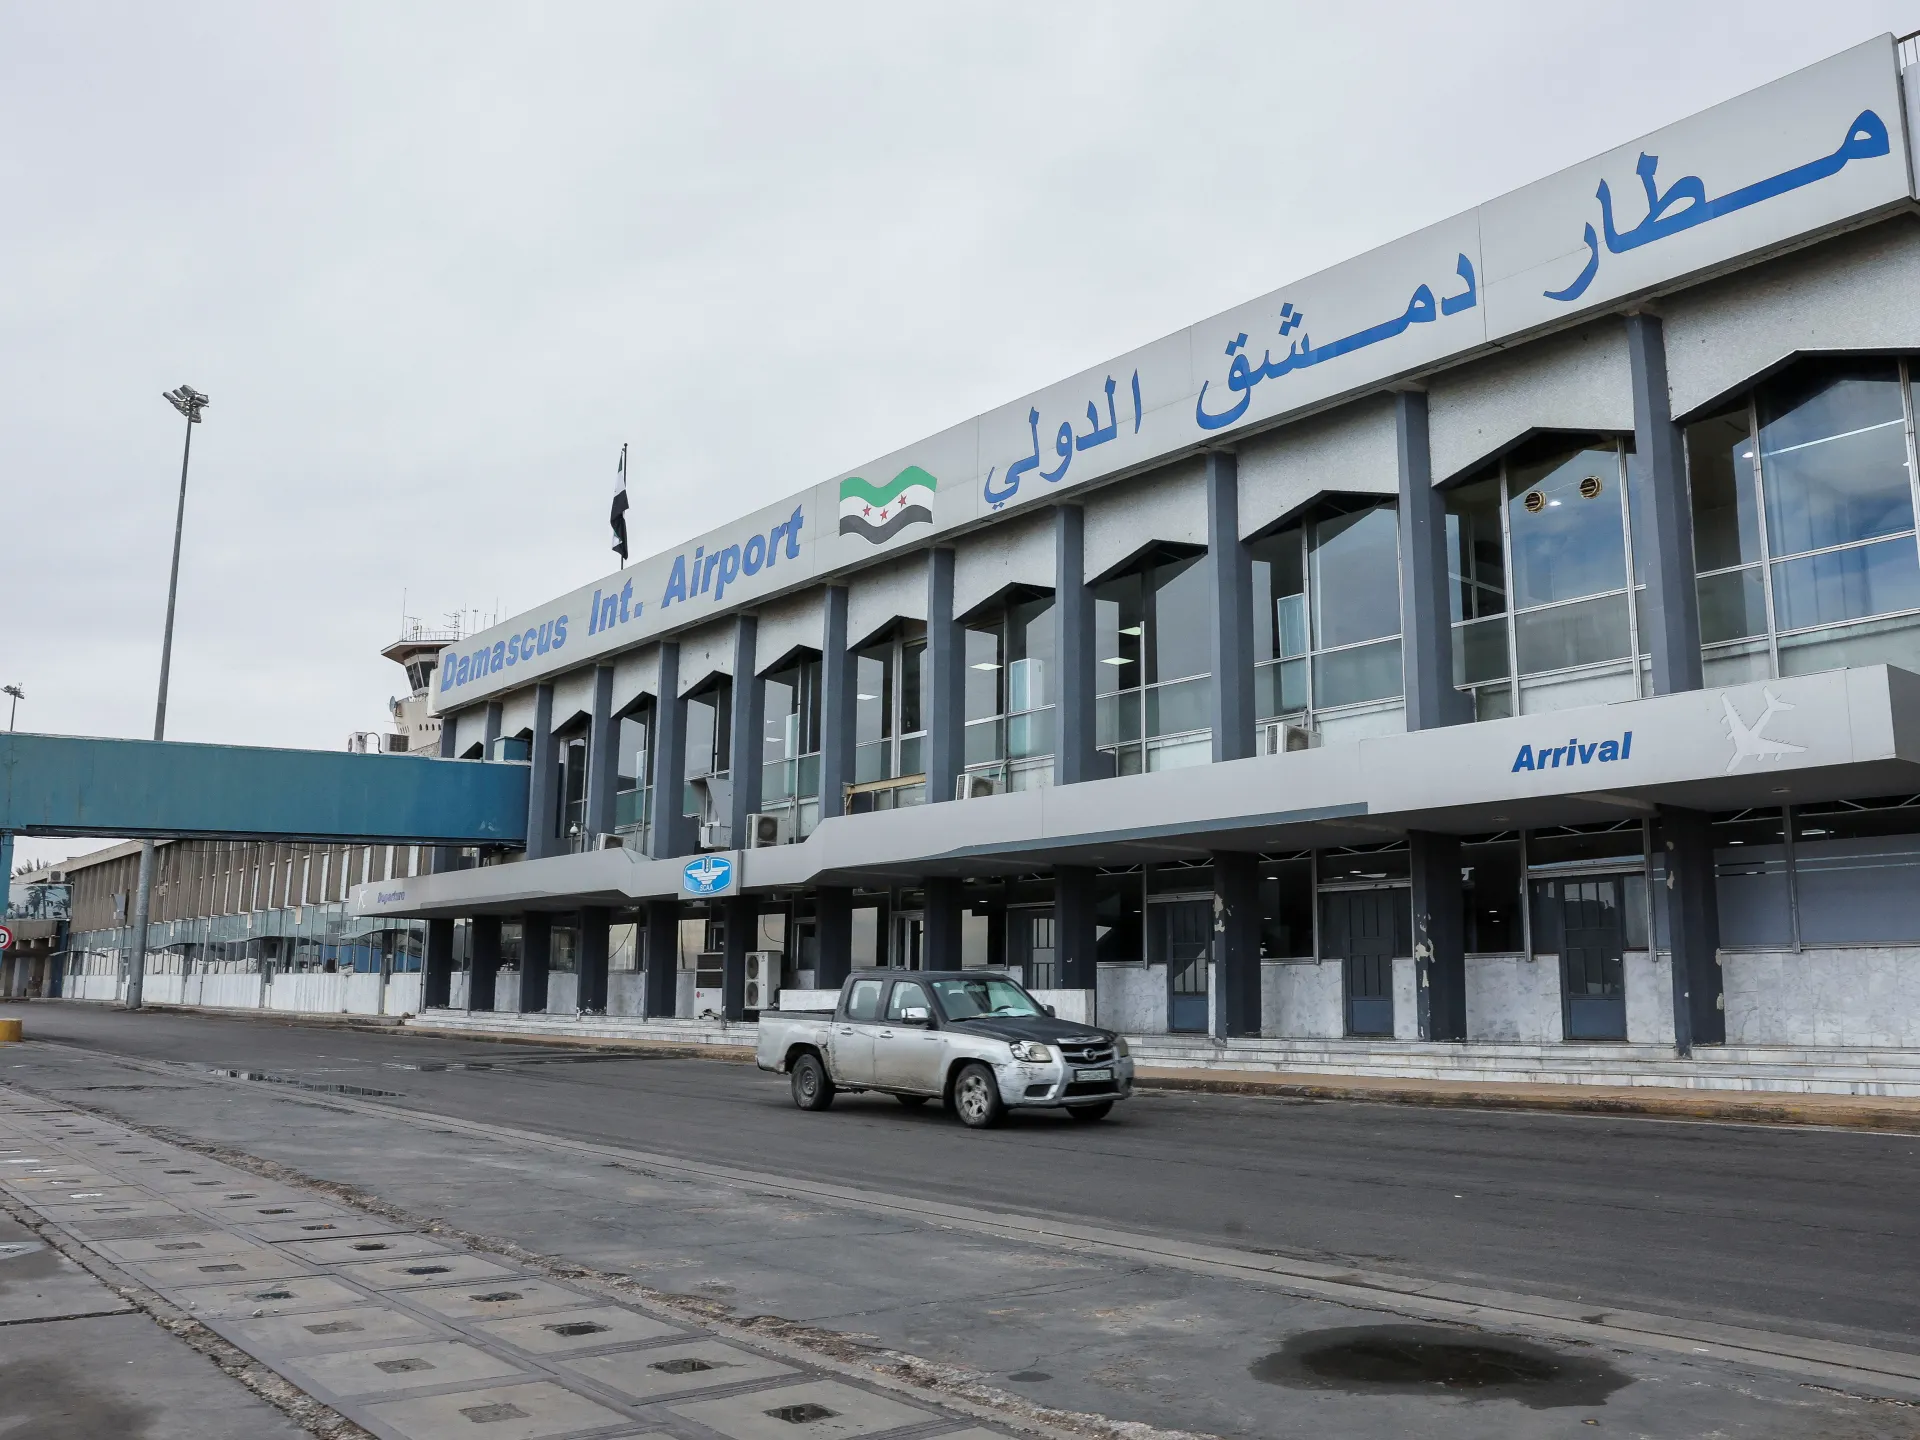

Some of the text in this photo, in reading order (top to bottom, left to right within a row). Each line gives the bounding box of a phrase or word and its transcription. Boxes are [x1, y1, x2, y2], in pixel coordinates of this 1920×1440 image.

[984, 109, 1891, 510] مطار دمشق الدولي
[440, 504, 804, 693] Damascus Int. Airport
[1511, 731, 1633, 774] Arrival
